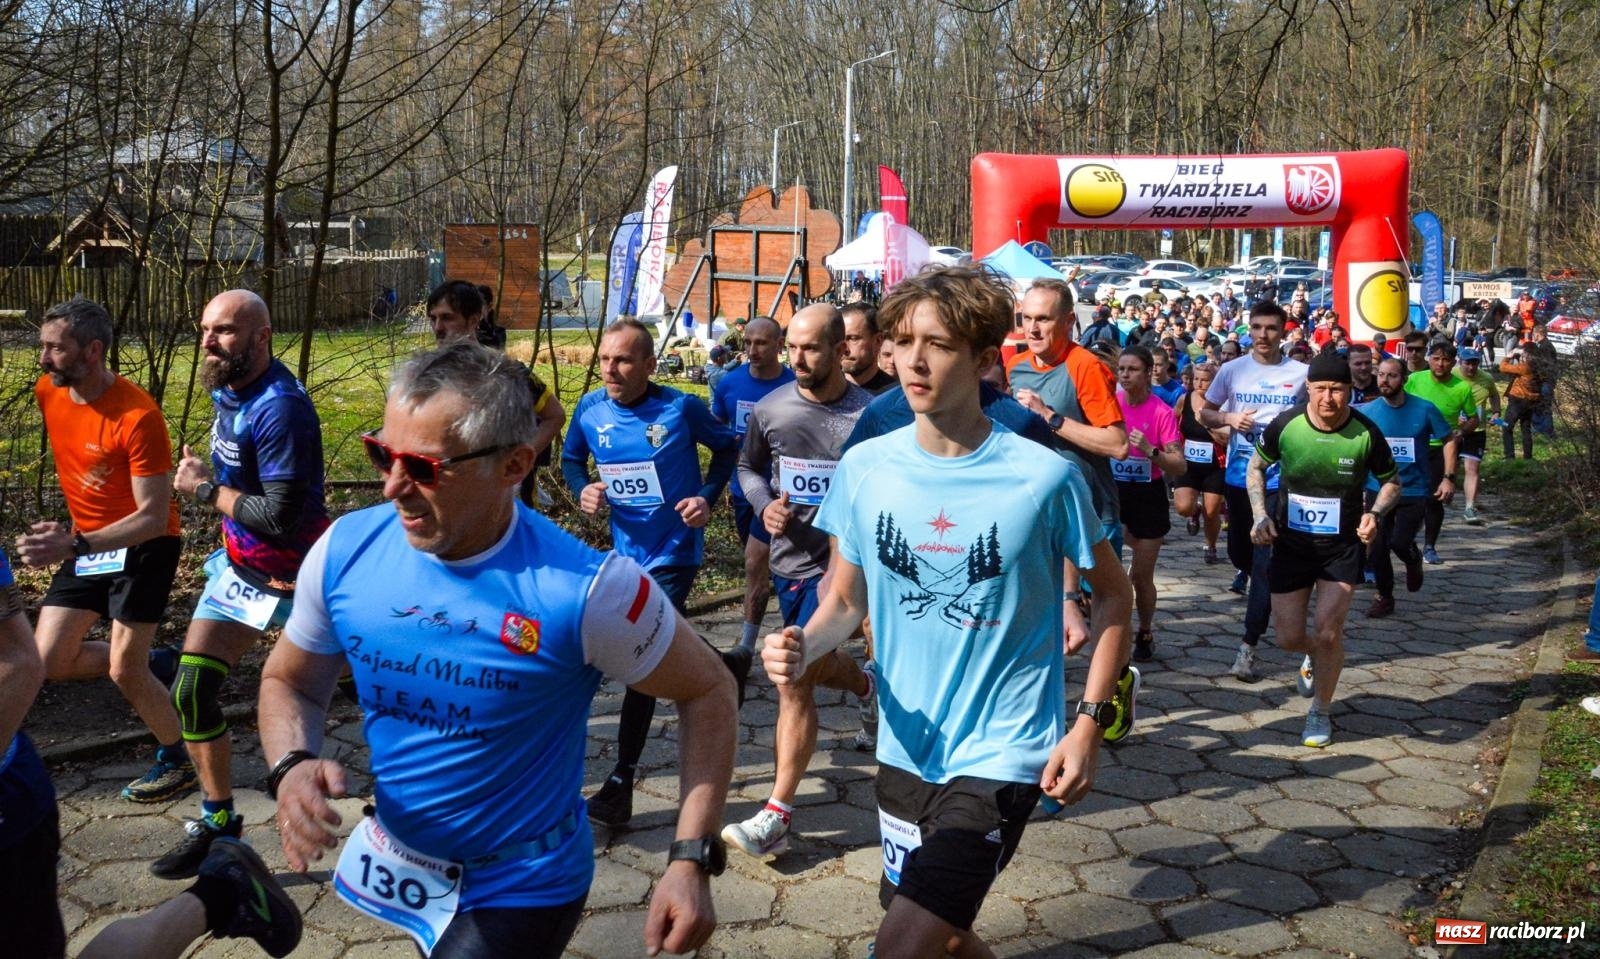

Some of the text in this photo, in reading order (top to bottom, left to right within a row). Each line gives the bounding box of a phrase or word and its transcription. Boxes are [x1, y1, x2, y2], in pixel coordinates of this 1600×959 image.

[1093, 170, 1124, 183] SIR
[1177, 164, 1224, 175] BIEG
[1139, 182, 1267, 198] TWARDZIELA
[1235, 393, 1297, 405] RUNNERS
[598, 434, 612, 448] PL
[1189, 447, 1207, 457] 012
[1392, 446, 1407, 456] 95
[1114, 463, 1144, 474] 044
[612, 478, 649, 495] 059
[793, 475, 830, 493] 061
[1298, 508, 1328, 524] 107
[348, 635, 520, 691] Zajazd Malibu
[371, 684, 472, 721] TEAM
[360, 853, 429, 911] 130
